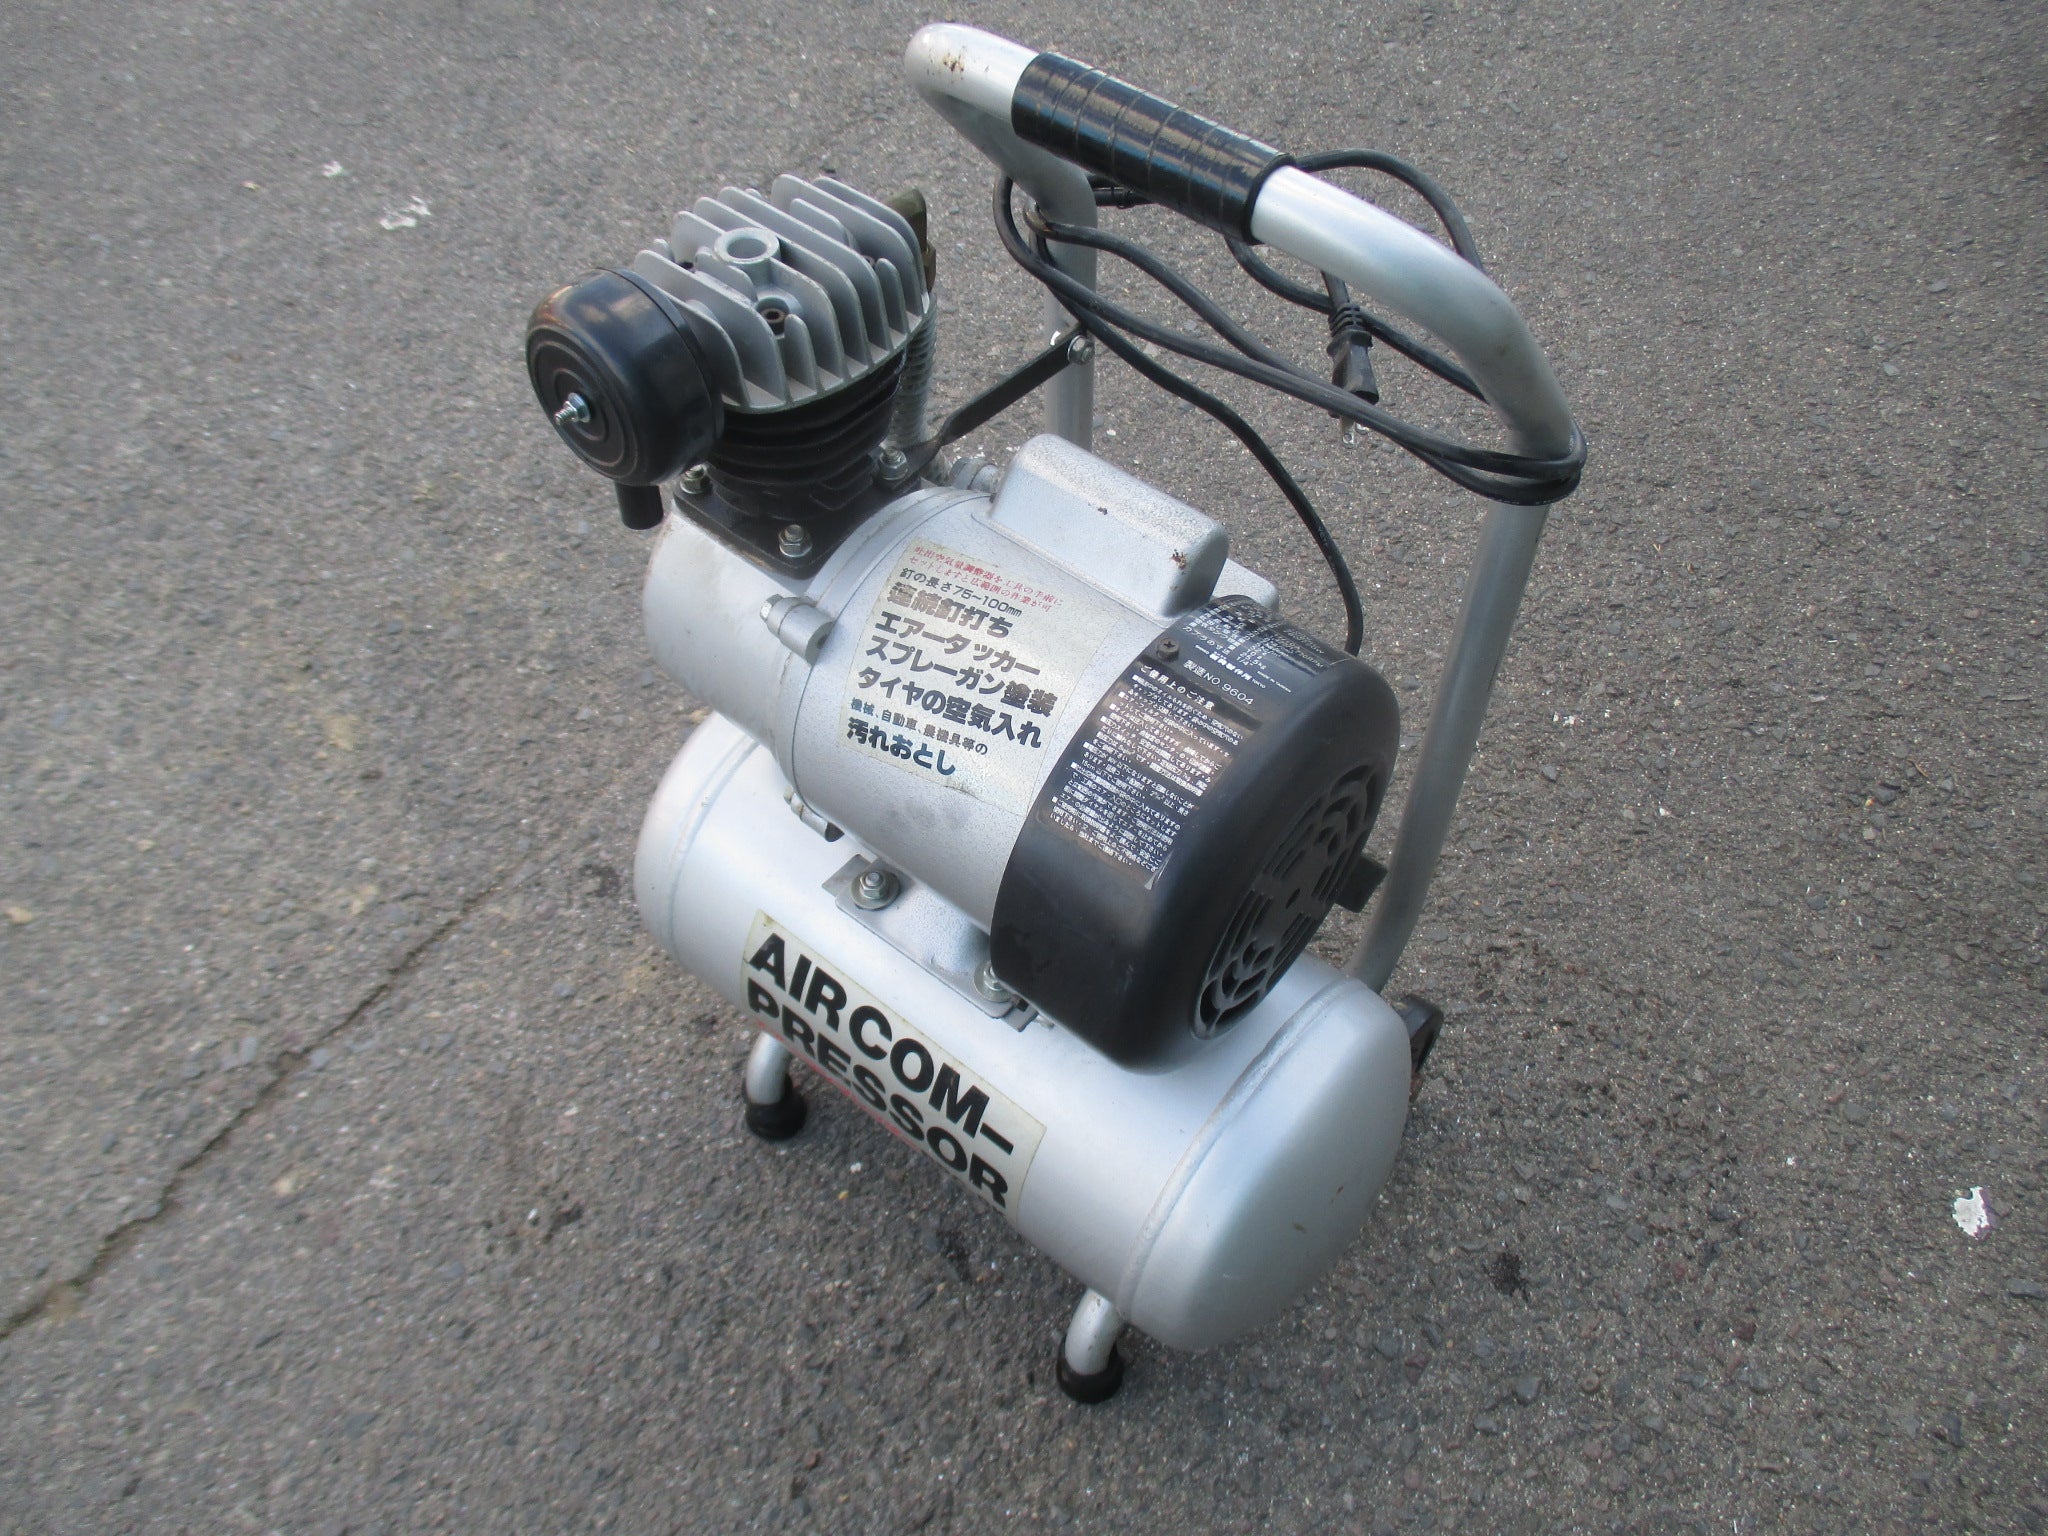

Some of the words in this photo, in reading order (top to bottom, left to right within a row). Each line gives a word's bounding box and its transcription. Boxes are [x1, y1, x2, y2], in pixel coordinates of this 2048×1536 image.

[887, 581, 1013, 638] 連続釘打ち
[875, 610, 1040, 675] エアータッカー
[858, 666, 1042, 748] タイヤの空気入れ
[866, 635, 1058, 717] スプレーガン塗装
[1140, 665, 1215, 711] ご使用上のご注意
[846, 716, 955, 775] 汚れおとし
[850, 697, 988, 755] 機械、自動車、農機具等の
[747, 977, 1008, 1208] PRESSOR
